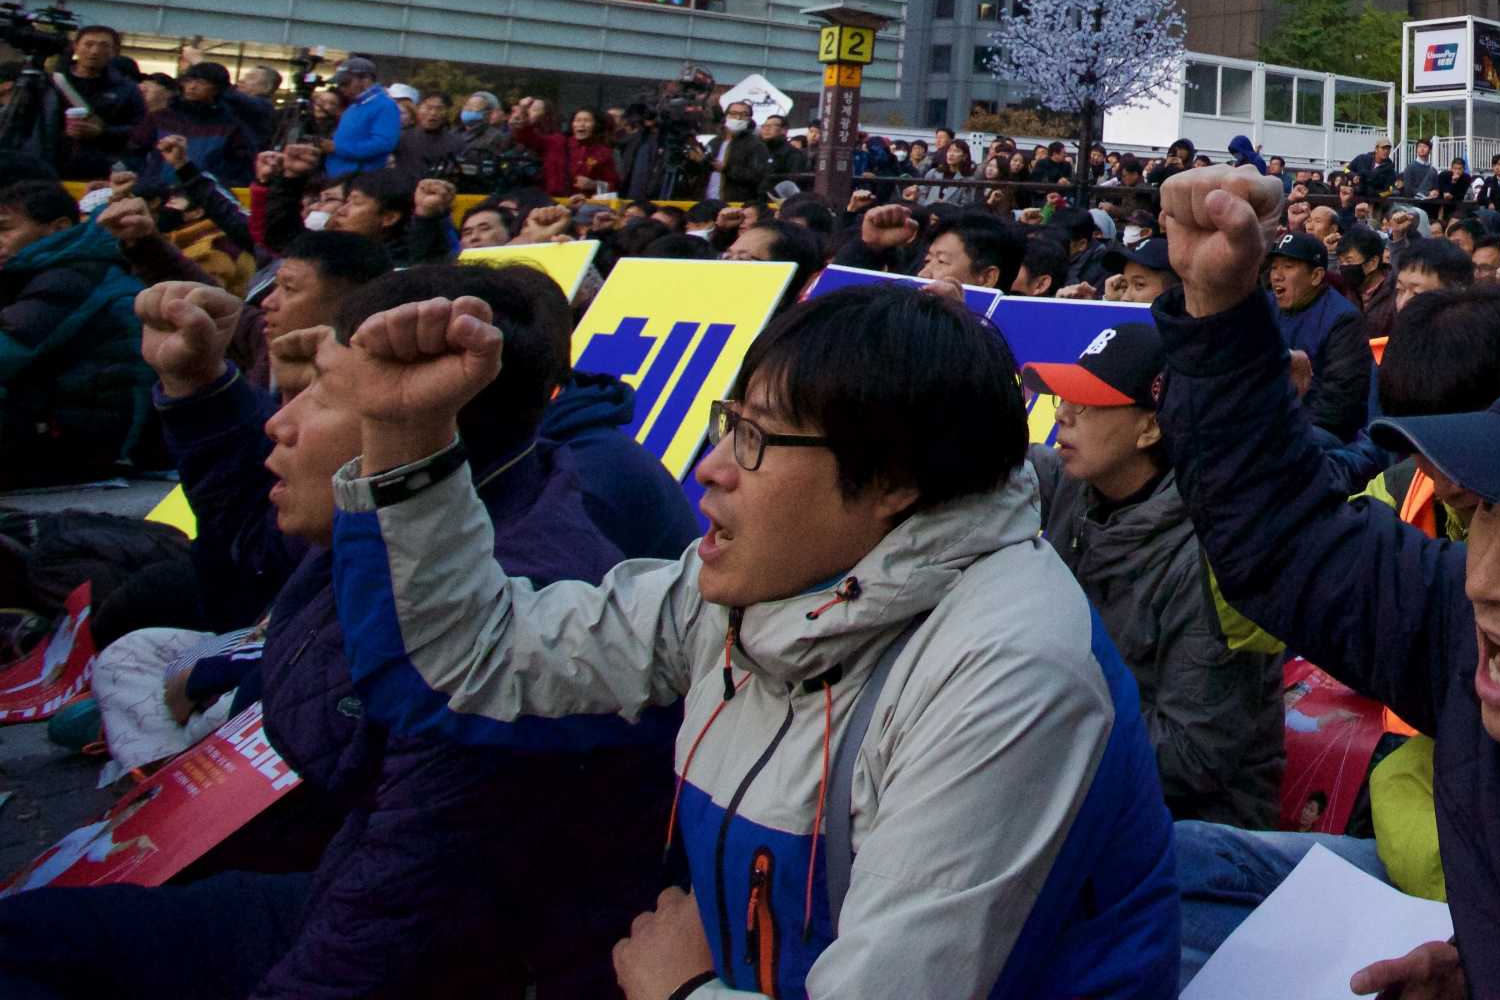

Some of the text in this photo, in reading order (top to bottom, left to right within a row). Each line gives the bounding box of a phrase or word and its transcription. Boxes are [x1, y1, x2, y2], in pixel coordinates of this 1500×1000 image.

[824, 31, 835, 55] 2
[848, 31, 865, 56] 2
[1278, 234, 1294, 249] P
